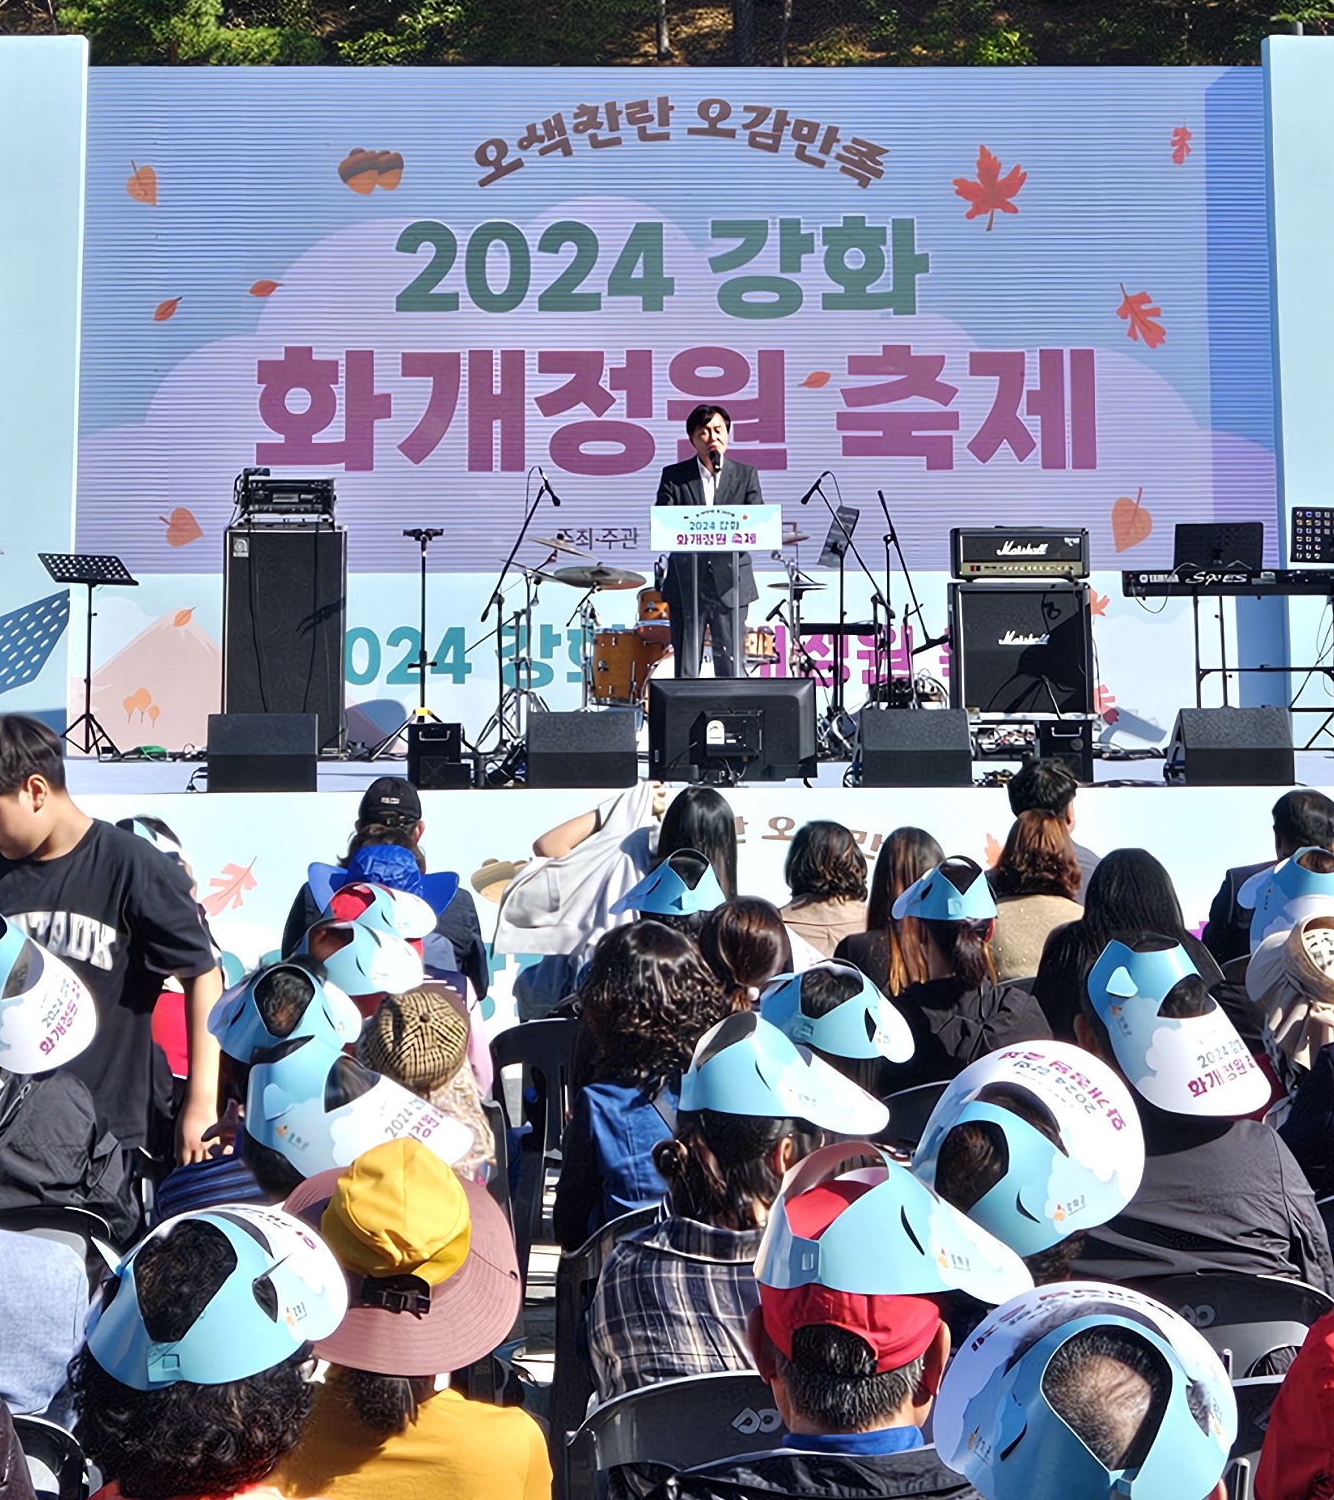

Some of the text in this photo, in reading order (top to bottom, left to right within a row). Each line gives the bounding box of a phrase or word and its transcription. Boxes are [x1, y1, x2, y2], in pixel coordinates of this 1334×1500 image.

[474, 96, 890, 189] 오색찬란 오감만족
[395, 214, 930, 319] 2024 강화
[254, 344, 1098, 475] 화개정원 축제
[689, 521, 715, 531] 2024
[996, 540, 1048, 556] Marshall
[345, 626, 472, 686] 024
[998, 630, 1050, 646] Marshall
[1187, 1058, 1248, 1098] 화개정원
